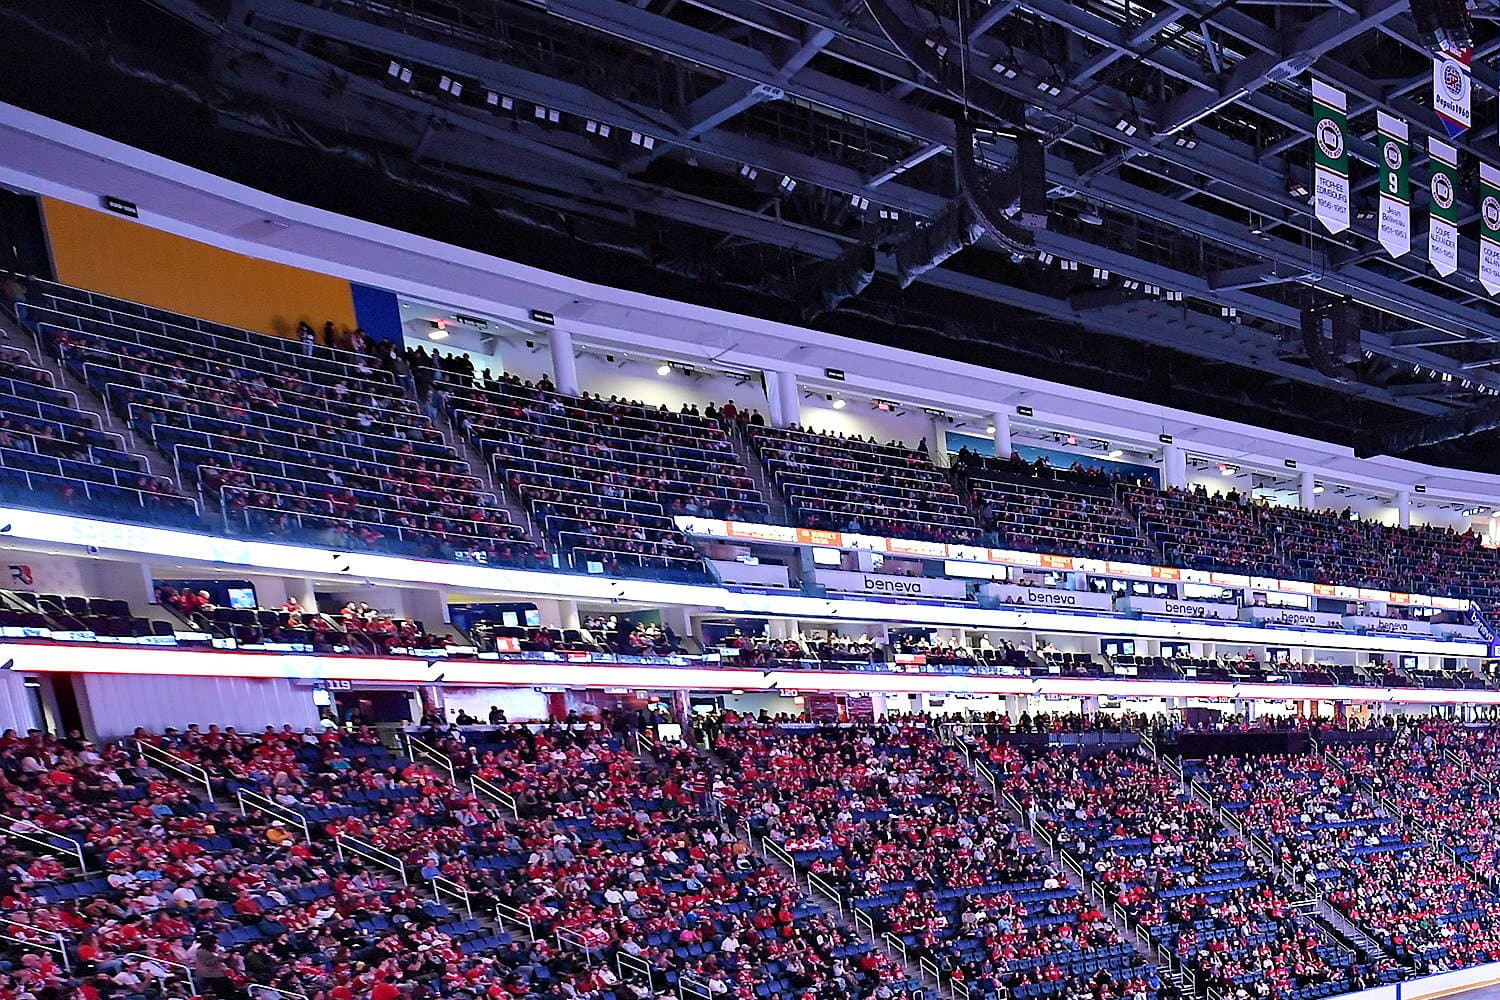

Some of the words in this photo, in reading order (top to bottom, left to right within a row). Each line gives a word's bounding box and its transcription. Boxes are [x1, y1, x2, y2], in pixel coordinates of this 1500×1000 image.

[1436, 94, 1456, 112] Depuis
[1456, 104, 1470, 119] 1960
[1388, 172, 1398, 193] 9
[864, 575, 921, 594] beneva
[1028, 589, 1075, 605] beneva
[1165, 601, 1205, 615] beneva
[1281, 610, 1315, 625] beneva
[1378, 619, 1408, 632] beneva
[1471, 612, 1494, 642] beneva
[326, 680, 350, 690] 119
